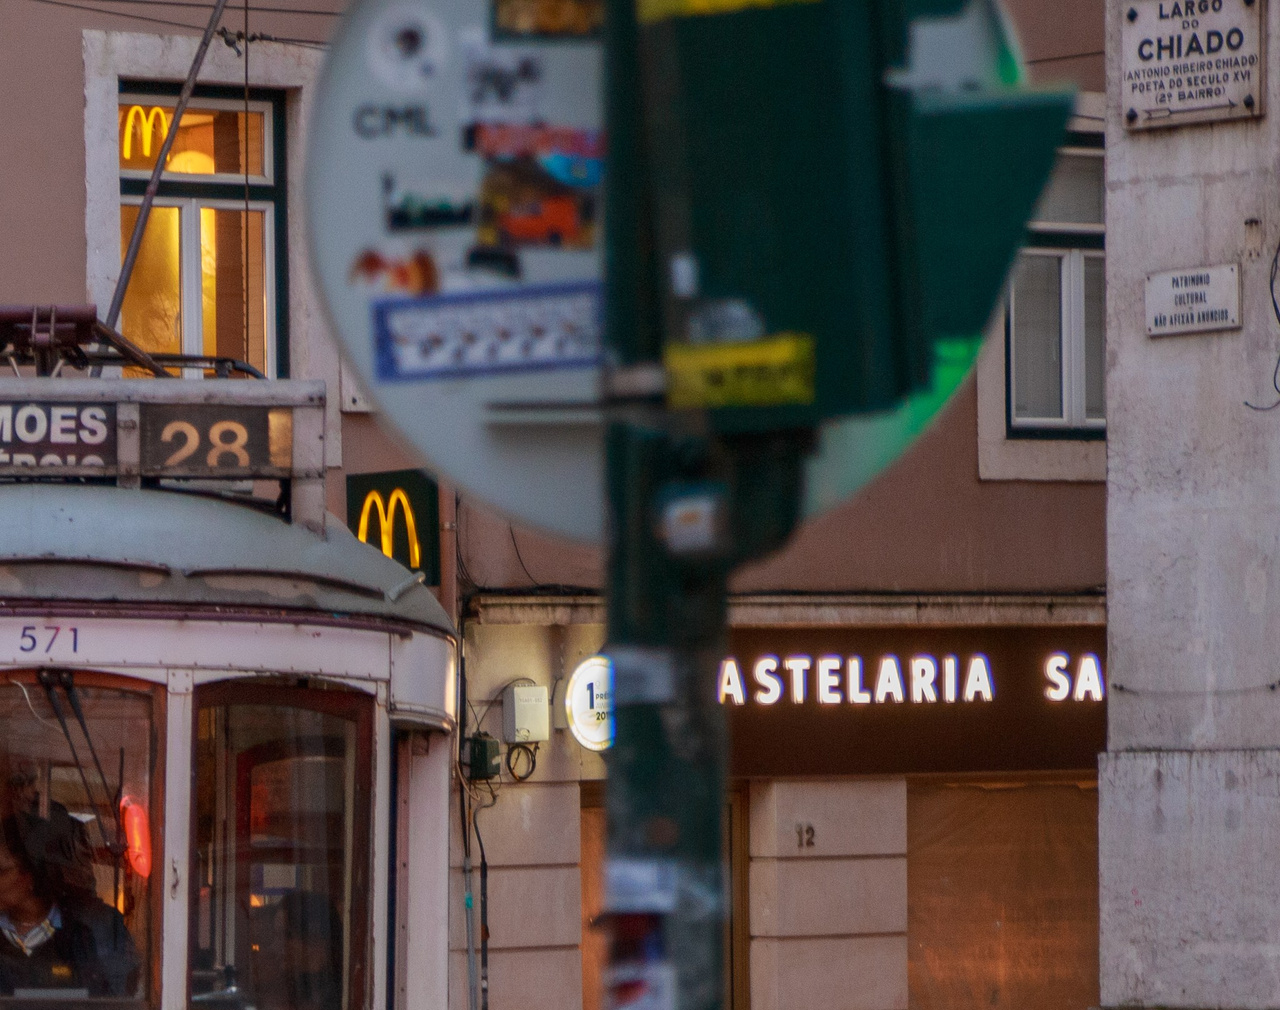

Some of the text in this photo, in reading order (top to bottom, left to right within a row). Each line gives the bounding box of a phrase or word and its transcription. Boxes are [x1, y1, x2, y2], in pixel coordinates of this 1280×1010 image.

[1159, 0, 1223, 20] LARGO
[1182, 19, 1199, 30] DO
[1138, 27, 1244, 61] CHIADO
[1173, 60, 1213, 75] RIBEIRO
[1131, 80, 1165, 93] POETA
[1170, 77, 1182, 89] DO
[1233, 70, 1251, 82] XVI
[161, 421, 250, 467] 28
[20, 626, 78, 653] 571
